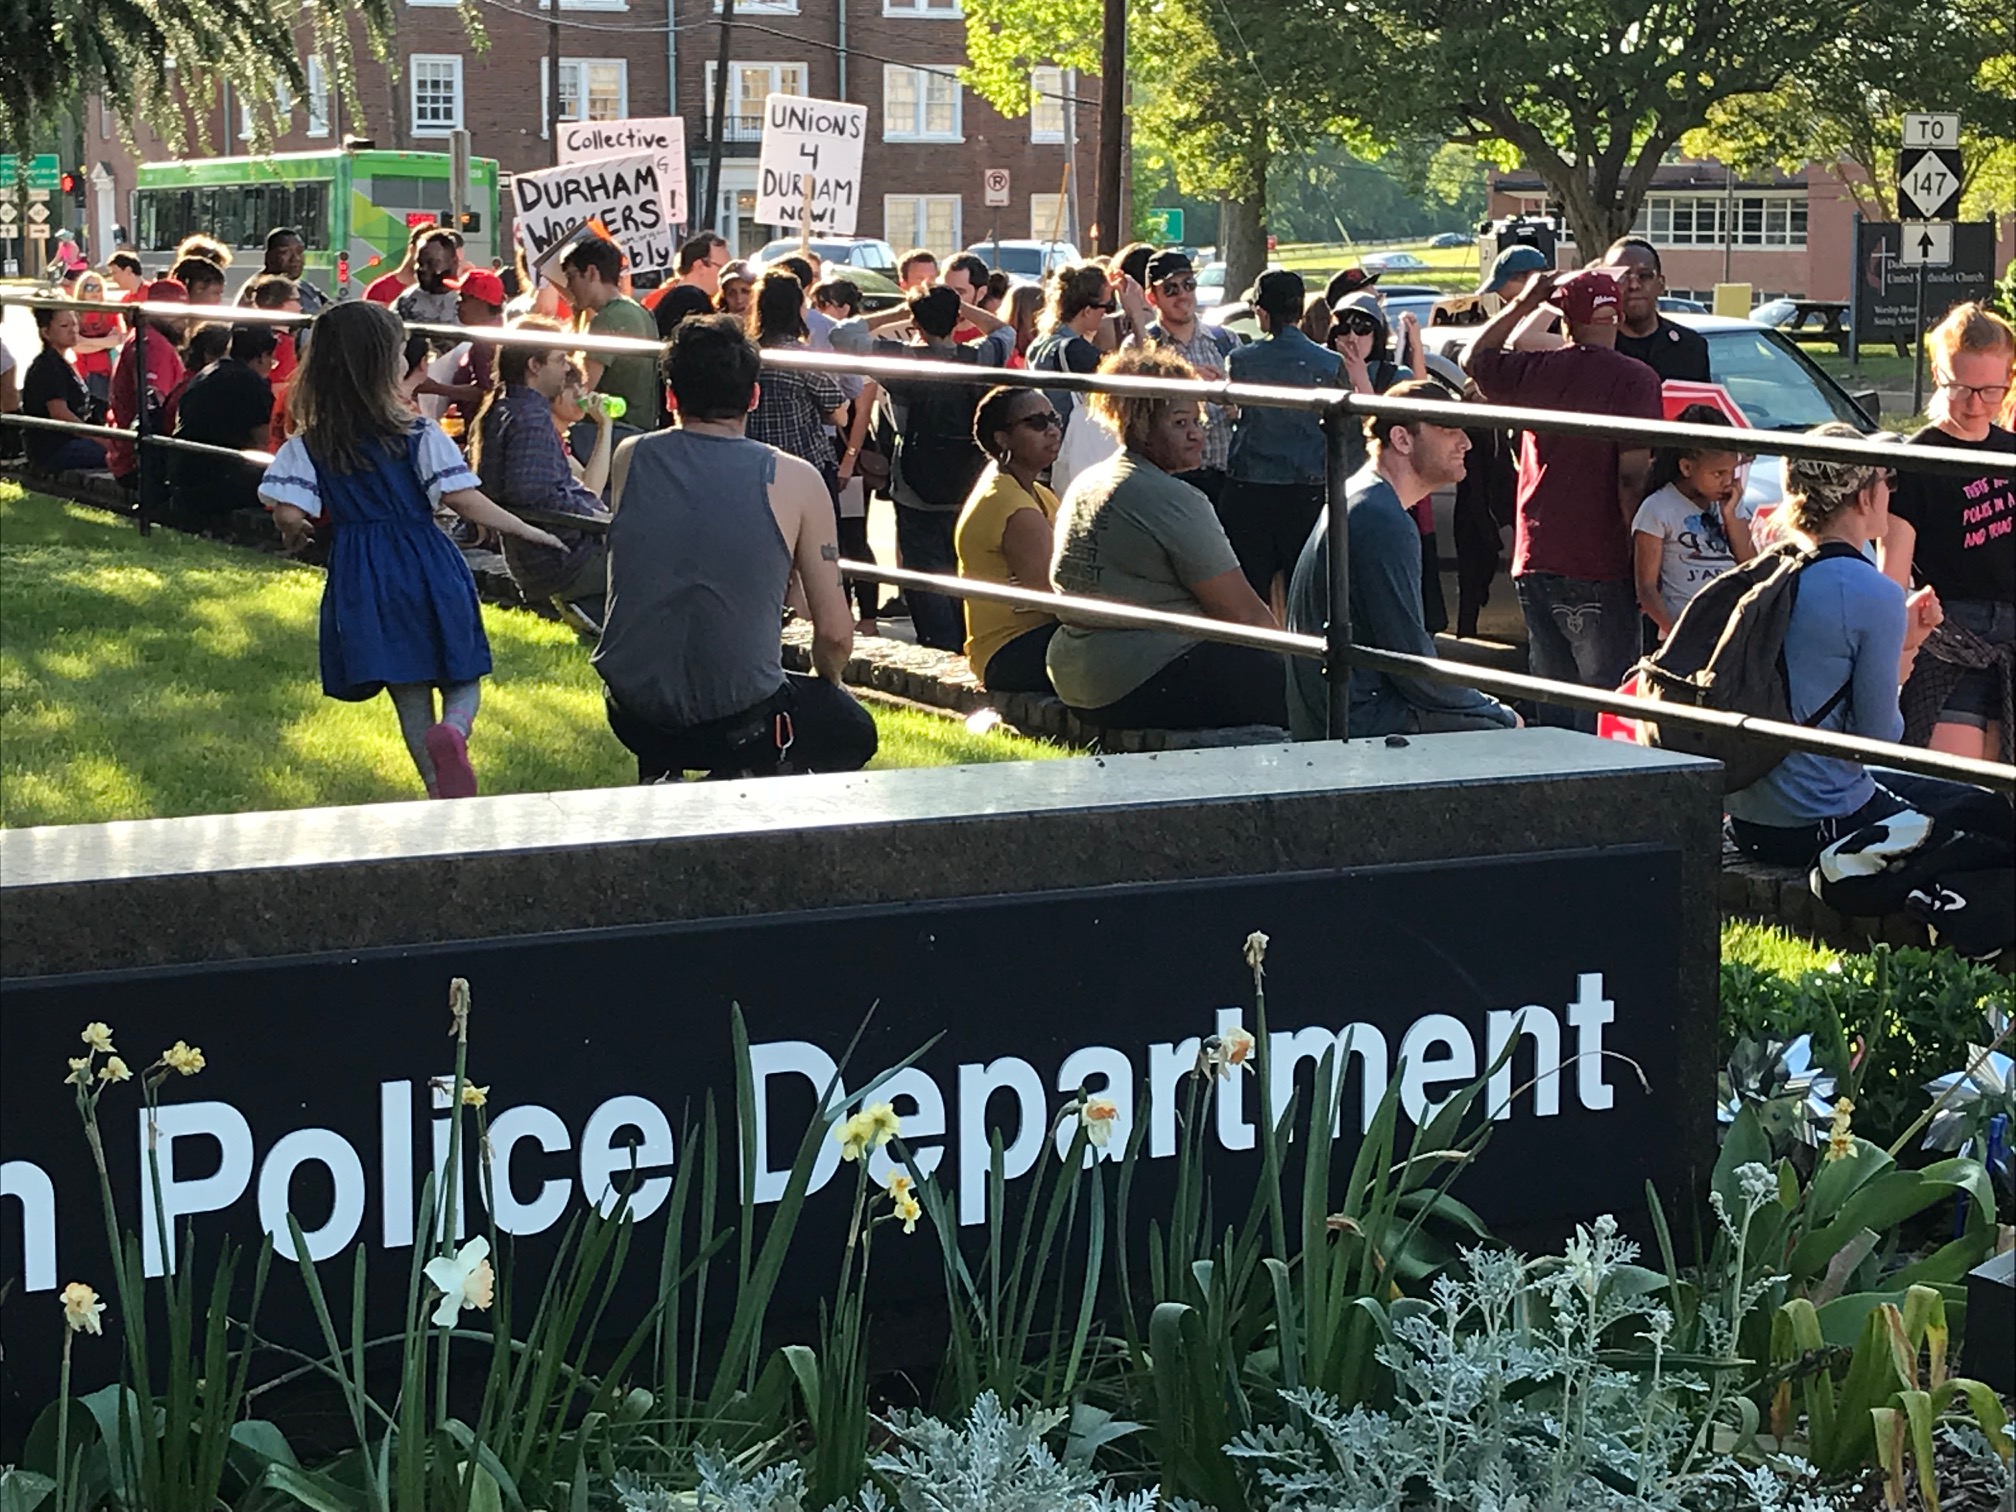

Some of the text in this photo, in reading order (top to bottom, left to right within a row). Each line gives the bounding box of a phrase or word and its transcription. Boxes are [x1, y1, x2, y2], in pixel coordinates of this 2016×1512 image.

[771, 104, 860, 139] UNiONS
[1918, 120, 1944, 139] TO
[566, 128, 669, 151] Collective
[799, 142, 819, 171] 4
[516, 165, 659, 212] DURHAM
[1913, 172, 1948, 196] 147
[525, 199, 661, 254] WORERS
[139, 1075, 675, 1279] Police
[740, 972, 1615, 1227] Department
